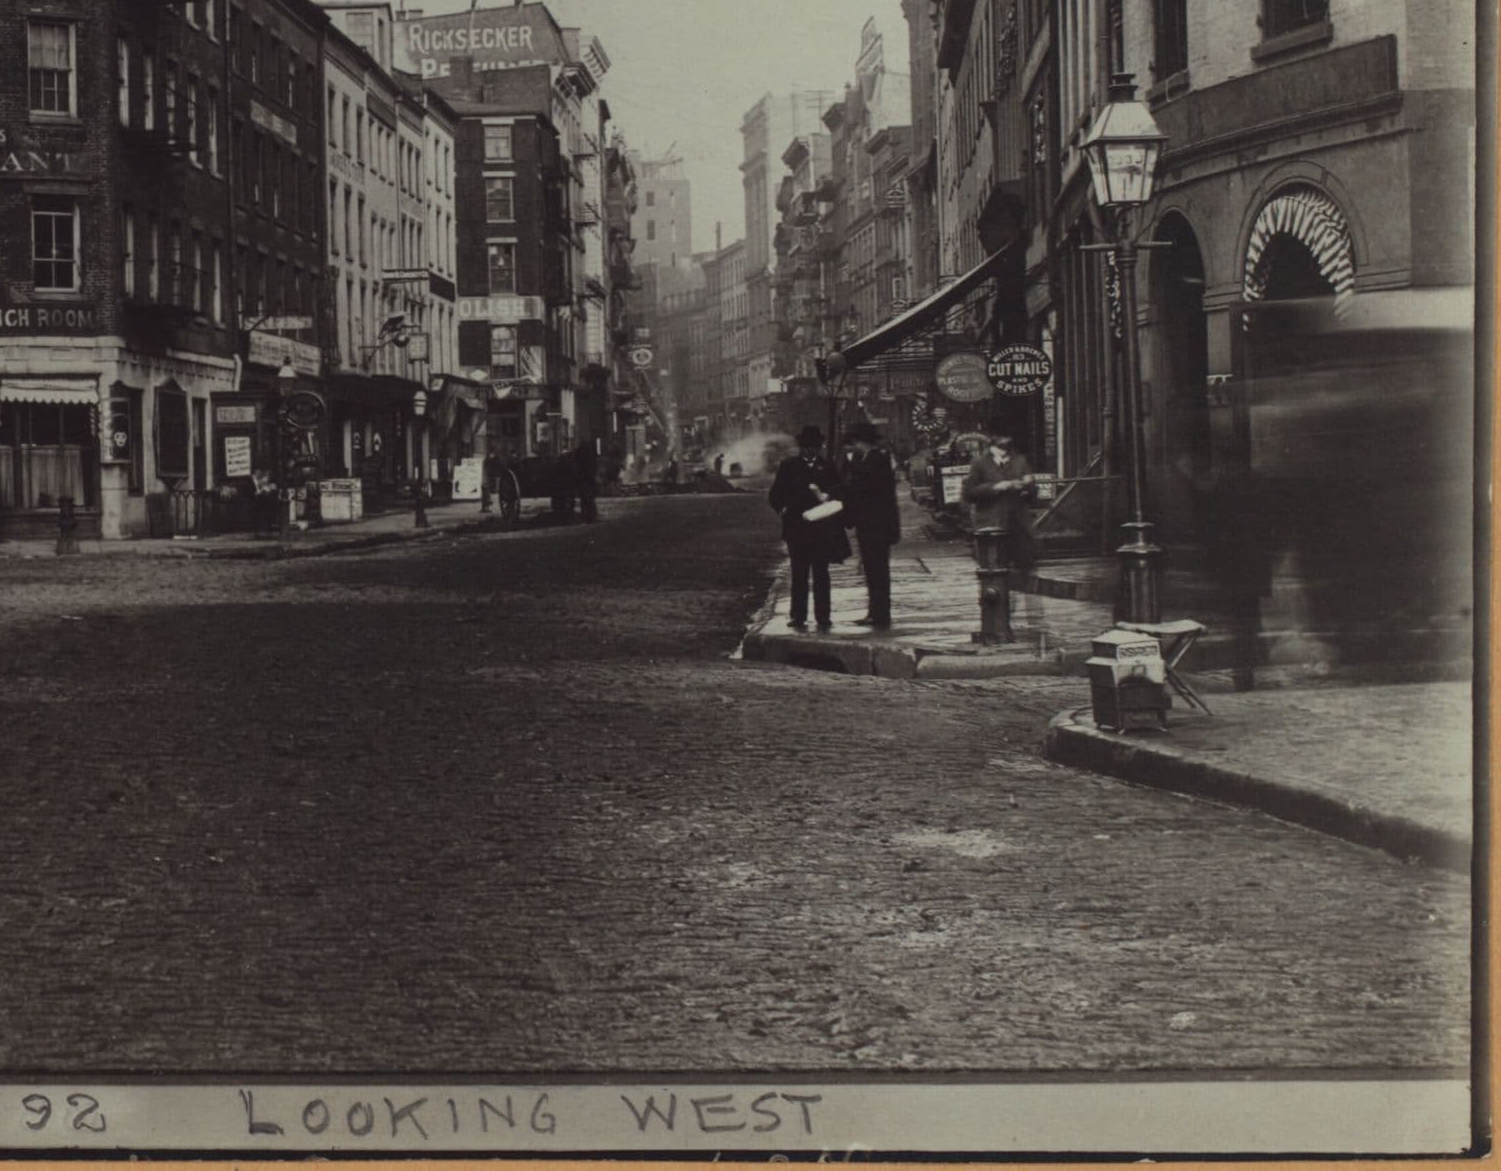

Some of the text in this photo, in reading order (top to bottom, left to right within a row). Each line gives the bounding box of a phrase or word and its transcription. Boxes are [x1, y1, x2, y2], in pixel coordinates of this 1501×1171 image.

[409, 23, 534, 55] RICKSECKER
[37, 308, 94, 329] ROOM
[988, 363, 1012, 377] CUT
[1014, 361, 1050, 375] NAILS
[995, 377, 1043, 394] SPIKES
